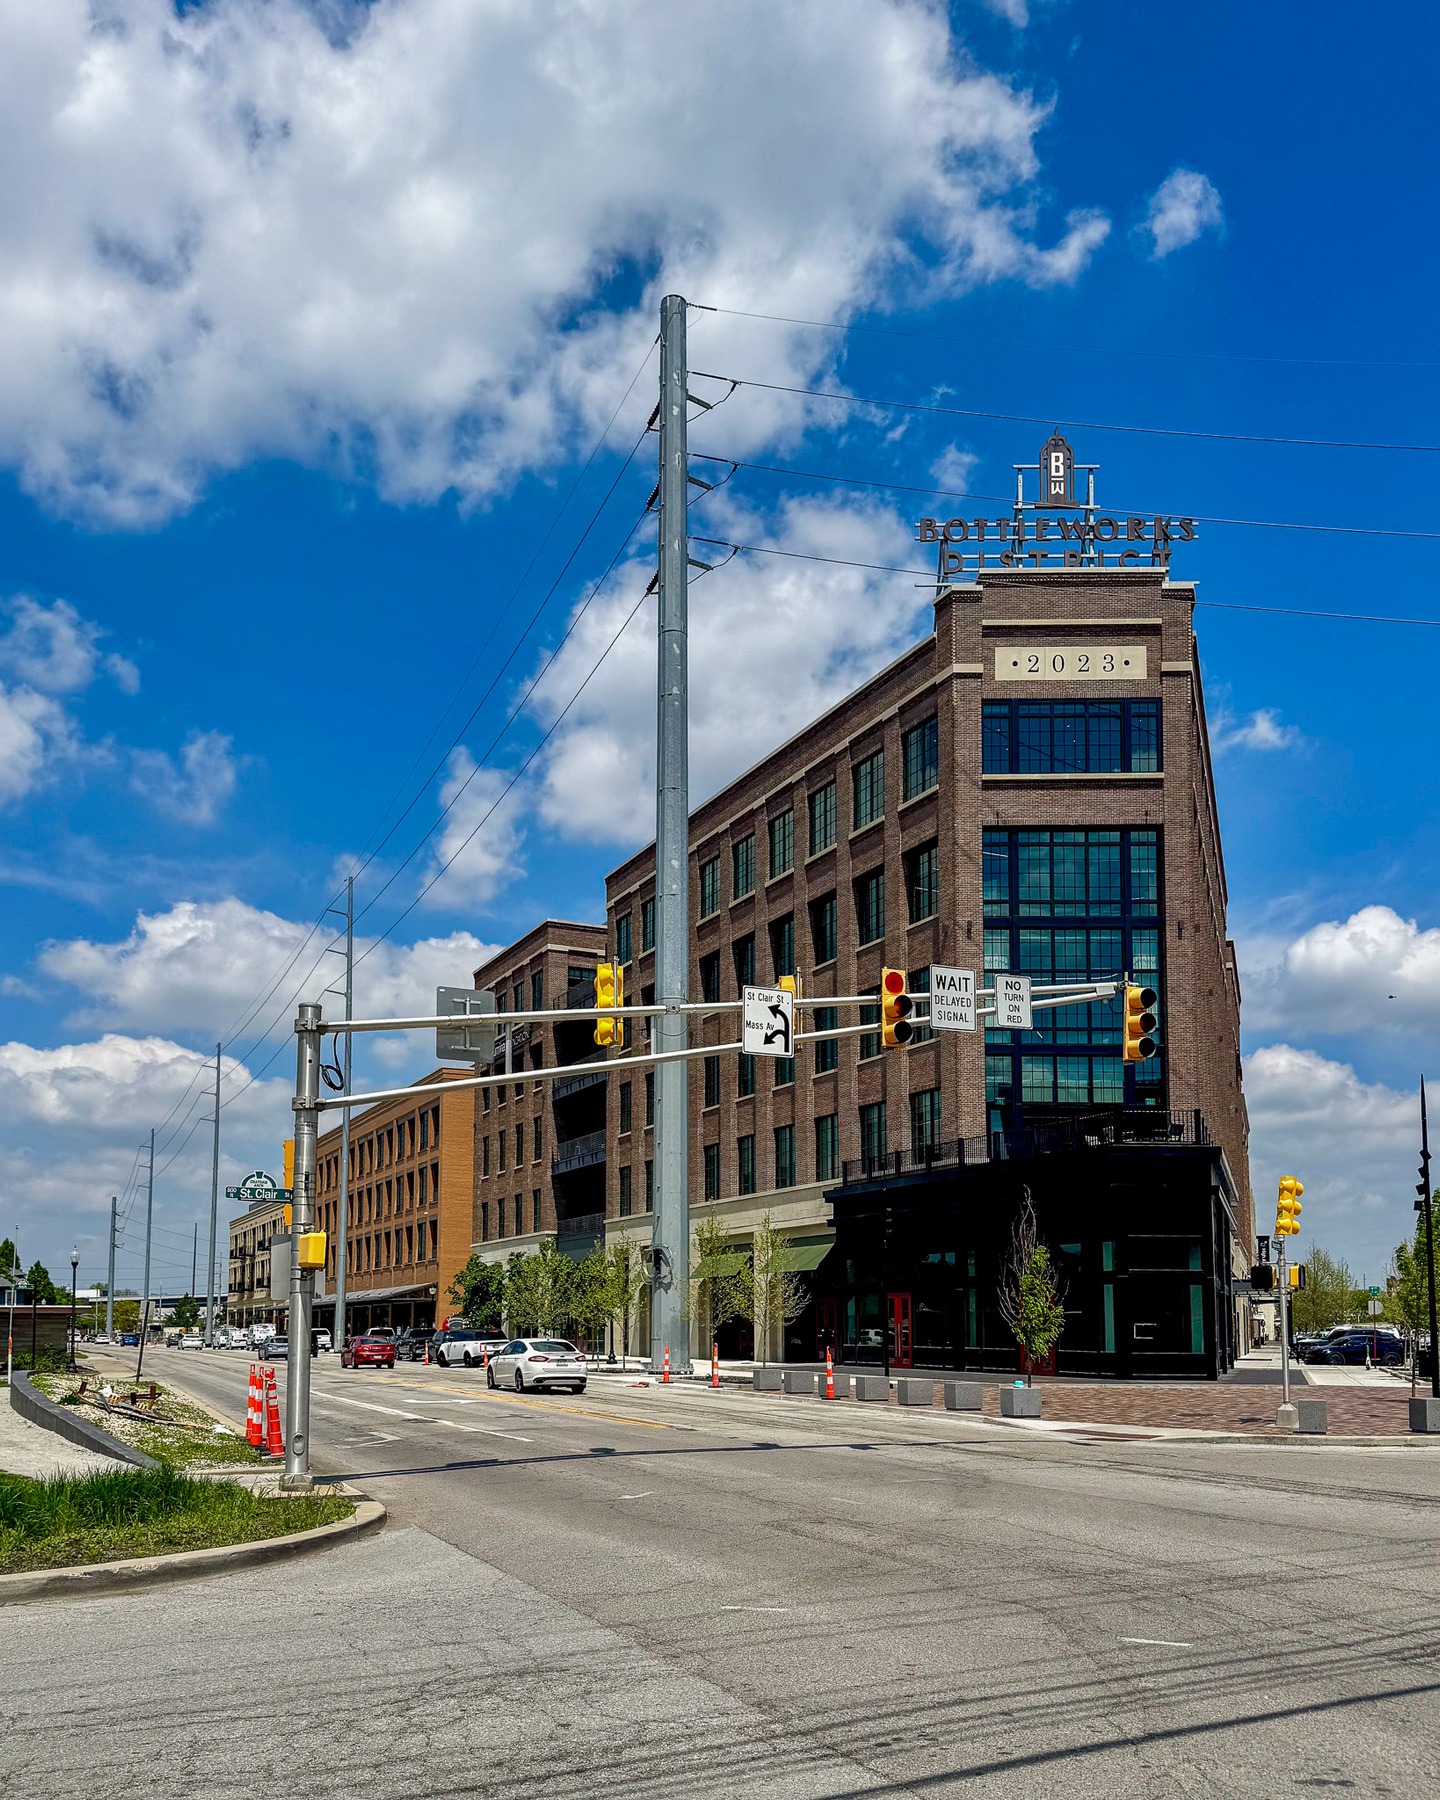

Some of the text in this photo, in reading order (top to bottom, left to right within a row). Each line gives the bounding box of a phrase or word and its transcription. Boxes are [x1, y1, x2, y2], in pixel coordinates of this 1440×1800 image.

[1051, 452, 1064, 476] B
[920, 517, 1195, 542] BOTTLEWORKS
[943, 549, 1172, 574] DISTRICT
[935, 974, 971, 993] WAIT
[1005, 980, 1022, 991] NO
[747, 991, 784, 1004] St Clair St
[934, 994, 972, 1008] DELAYED
[1003, 992, 1025, 1002] TURN
[1008, 1003, 1020, 1013] ON
[937, 1010, 970, 1023] SIGNAL
[1006, 1014, 1023, 1024] RED
[745, 1019, 775, 1031] Mass Av
[240, 1188, 253, 1199] St.
[255, 1188, 278, 1199] Clair
